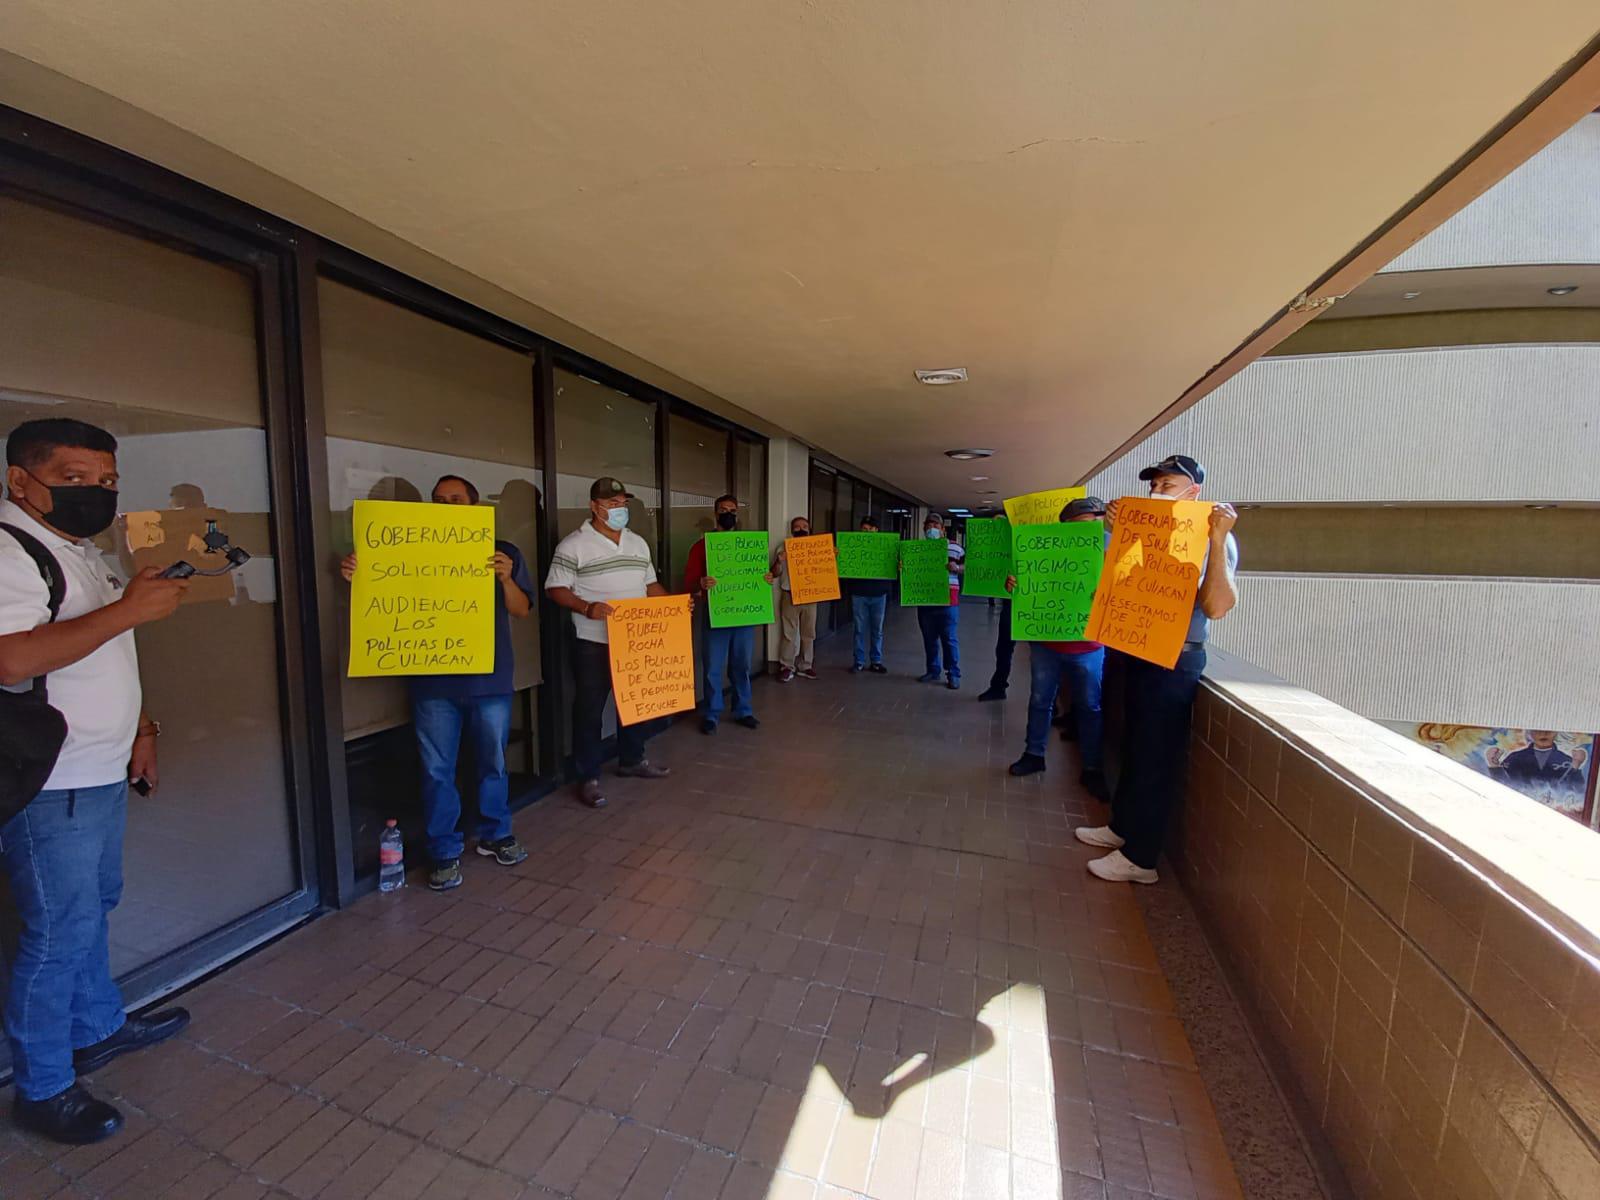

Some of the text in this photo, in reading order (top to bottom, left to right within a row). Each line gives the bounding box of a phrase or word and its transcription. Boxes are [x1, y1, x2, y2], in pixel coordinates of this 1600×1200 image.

[1118, 504, 1195, 533] GOBERNADOR
[365, 520, 493, 549] GOBERNADOR
[710, 536, 765, 551] LOS POLICIAS
[1015, 534, 1102, 553] GOBERNADOR
[1120, 527, 1140, 545] DE
[371, 561, 490, 582] SOLICITAMOS
[1015, 558, 1090, 576] EXIGIMOS
[1143, 553, 1194, 581] POLICIAS
[1020, 577, 1086, 596] JUSTICIA
[1115, 571, 1188, 602] DE CULIACAN
[364, 595, 479, 617] AUDIENCIA
[612, 604, 684, 622] GOBERNADOR
[1032, 596, 1066, 611] LOS
[1101, 591, 1178, 623] NESECITAMOS
[393, 616, 438, 633] LOS
[1017, 610, 1073, 623] POLICIAS
[1109, 608, 1153, 630] DE SU
[626, 621, 669, 639] RUBEN
[1101, 623, 1148, 649] AYUDA
[366, 636, 467, 656] POLICIAS DE
[628, 637, 665, 654] ROCHA
[377, 651, 474, 671] CULIACAN
[616, 655, 686, 673] LOS POLICIAS
[628, 673, 642, 687] DE
[621, 690, 637, 704] LE
[641, 682, 679, 698] PEDIMOS
[635, 698, 678, 717] ESCUCHE
